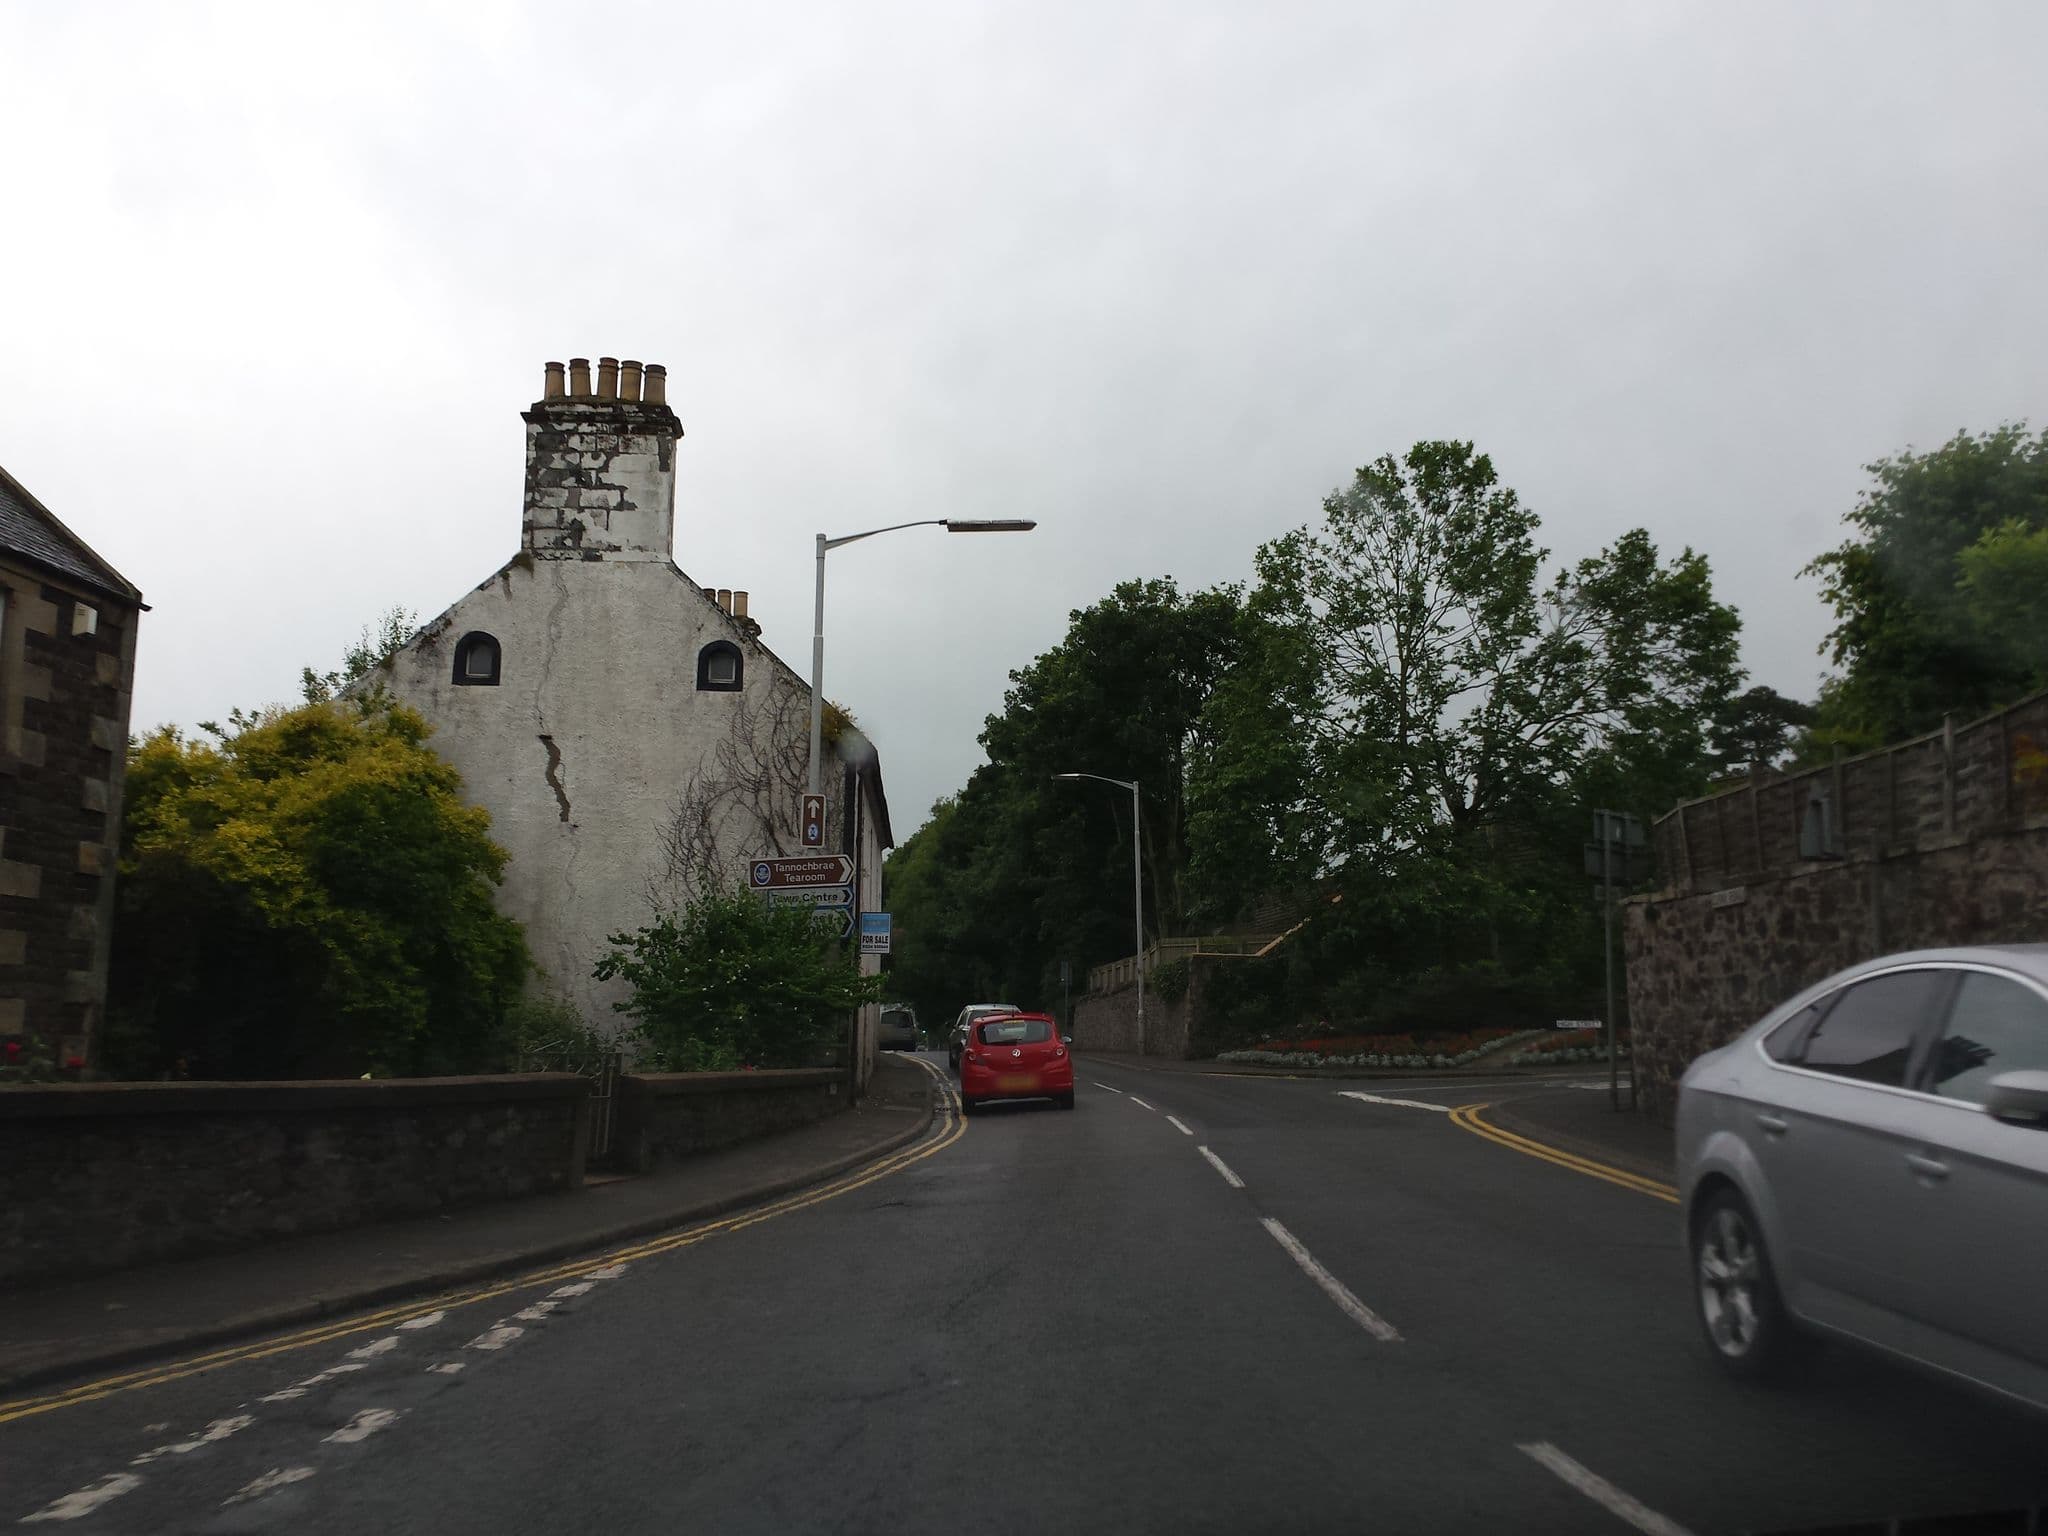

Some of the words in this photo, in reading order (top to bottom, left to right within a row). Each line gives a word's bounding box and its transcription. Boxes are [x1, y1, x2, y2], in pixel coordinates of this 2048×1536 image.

[774, 862, 835, 872] Tannochbrae
[785, 873, 826, 882] Tearoom
[802, 893, 838, 902] Centre
[863, 935, 874, 944] FOR
[875, 935, 888, 944] SALE
